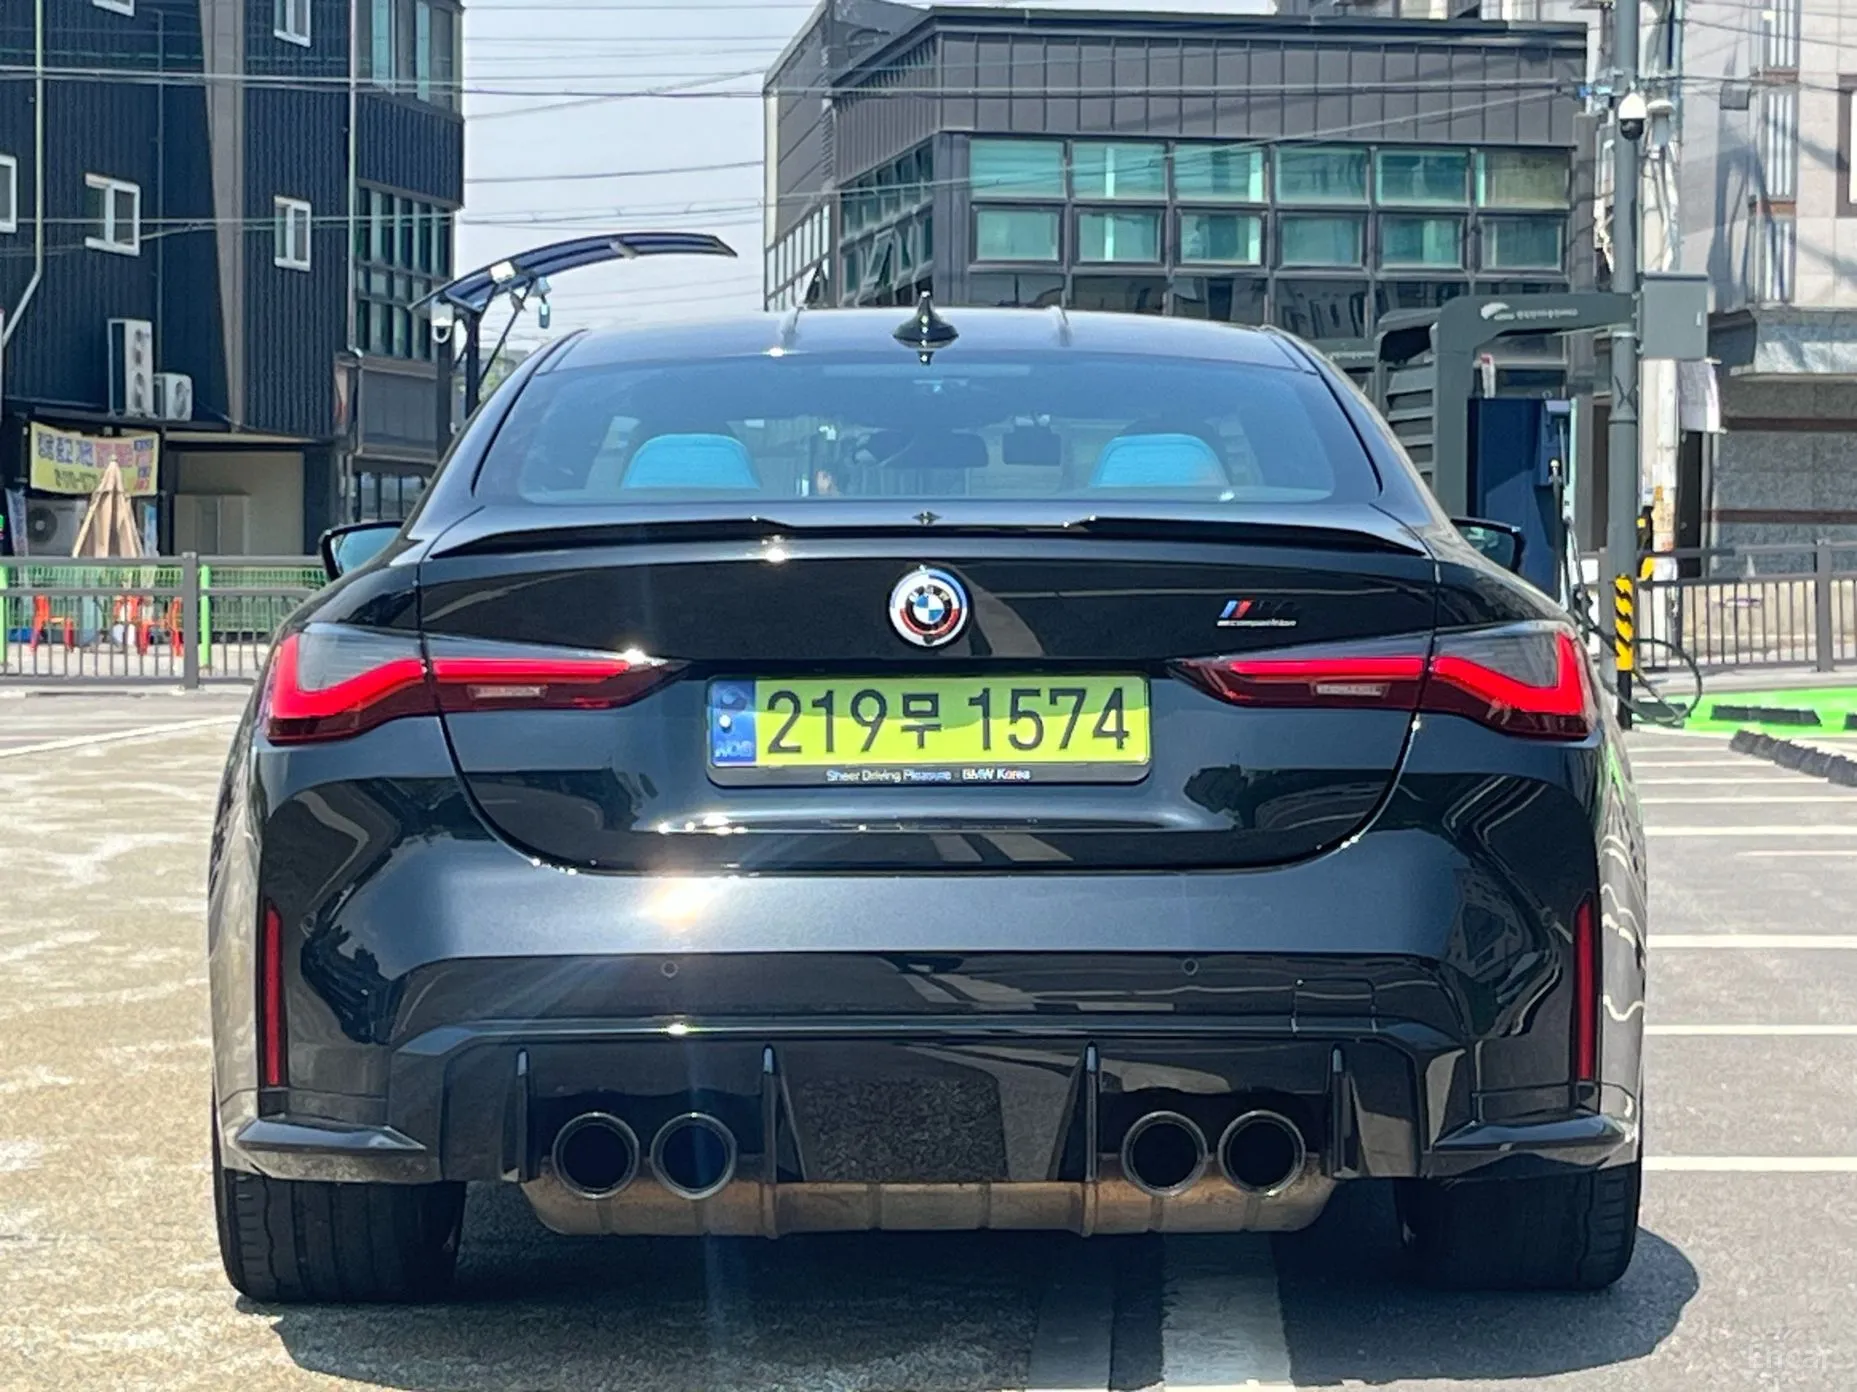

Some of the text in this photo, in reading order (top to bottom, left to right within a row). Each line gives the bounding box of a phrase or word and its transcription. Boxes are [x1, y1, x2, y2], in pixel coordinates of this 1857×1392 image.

[767, 688, 1129, 755] 219무 1574
[826, 770, 859, 782] Sheer
[862, 770, 902, 783] Driving
[962, 769, 995, 781] BMW
[997, 769, 1031, 781] Korea
